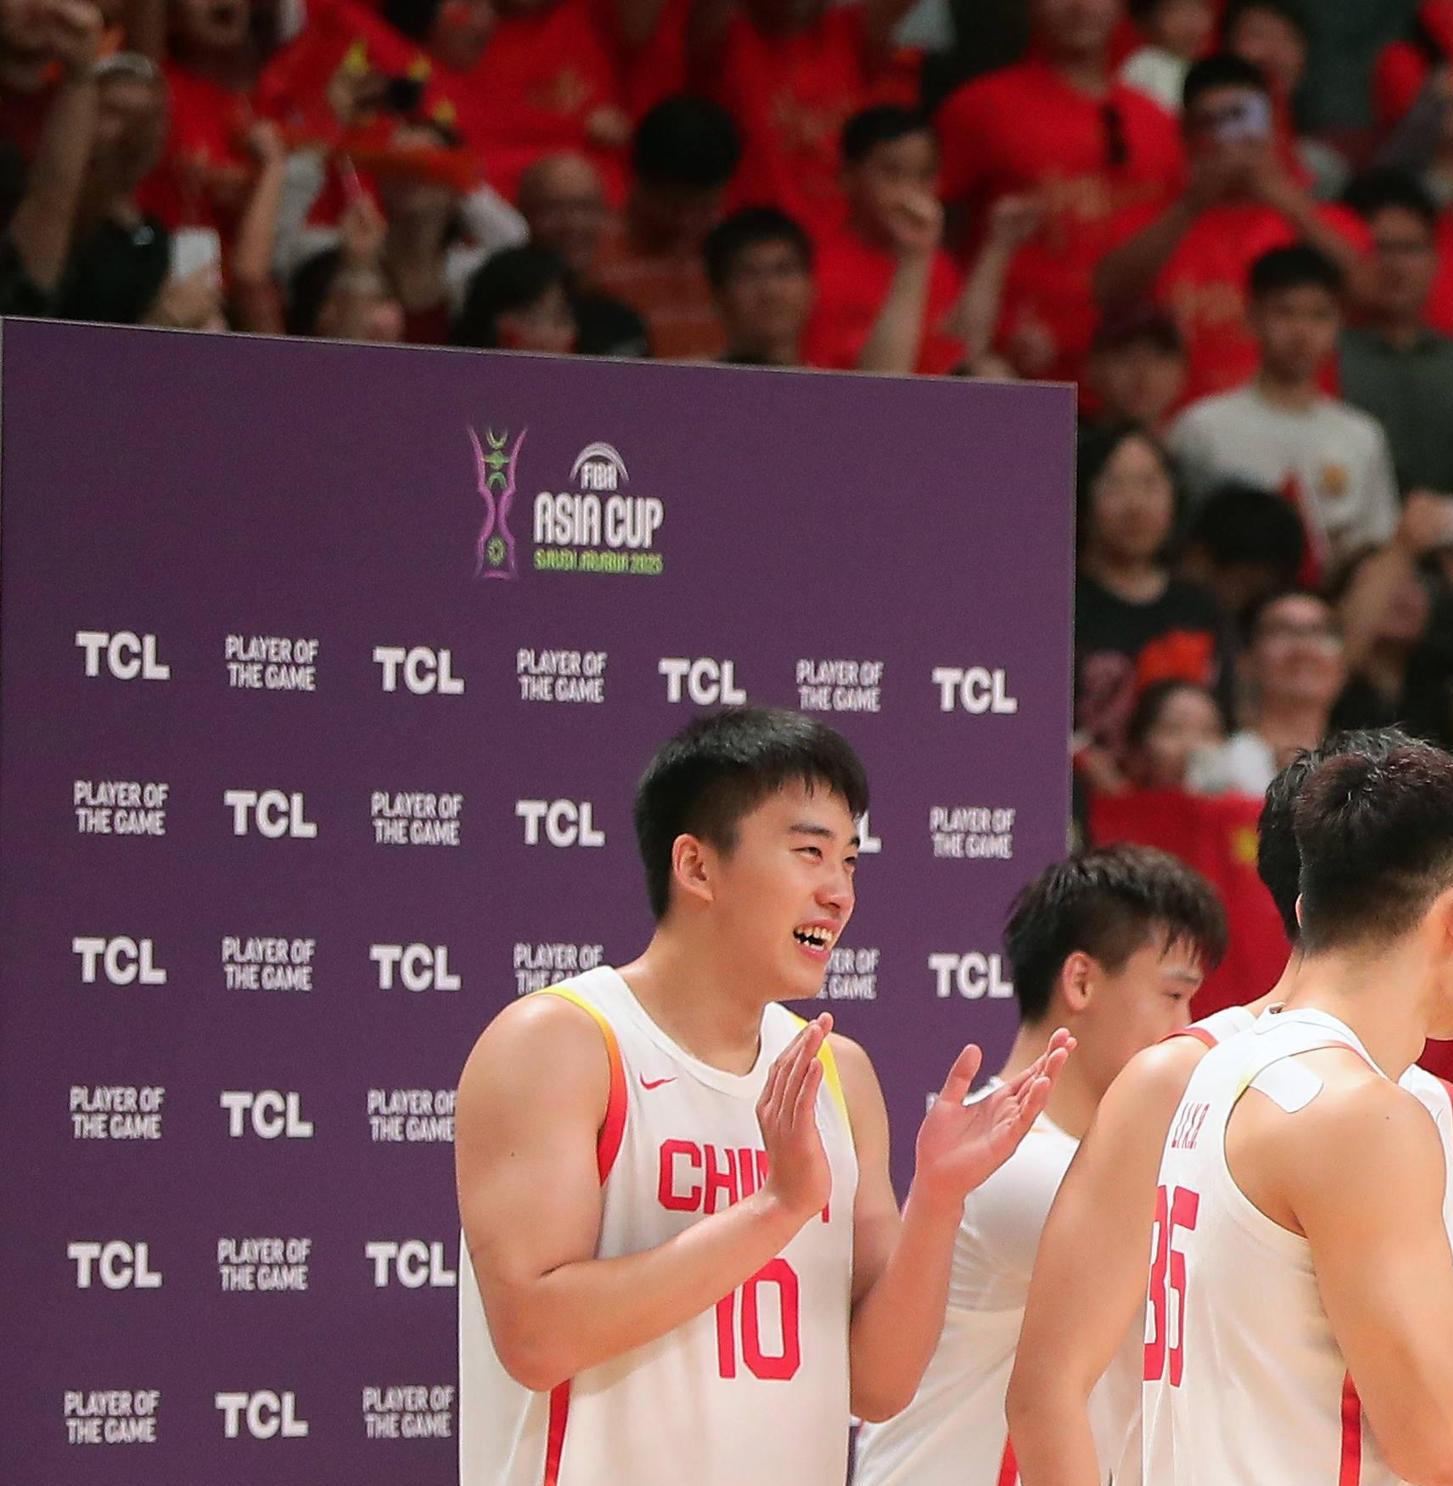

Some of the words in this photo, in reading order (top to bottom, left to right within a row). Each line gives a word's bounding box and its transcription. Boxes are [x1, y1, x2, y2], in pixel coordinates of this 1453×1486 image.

[580, 459, 619, 491] FIBA
[533, 491, 603, 546] ASIA
[604, 495, 665, 549] CUP
[75, 630, 170, 680] TCL
[225, 635, 292, 662] PLAYER
[293, 638, 319, 665] OF
[516, 648, 581, 674] PLAYER
[582, 651, 608, 677] OF
[227, 662, 263, 689] THE
[264, 664, 316, 691] GAME
[372, 646, 465, 695] TCL
[658, 657, 747, 706] TCL
[796, 659, 859, 685] PLAYER
[860, 662, 884, 688] OF
[518, 674, 554, 702] THE
[555, 676, 605, 704] GAME
[798, 684, 832, 711] THE
[833, 686, 882, 713] GAME
[931, 666, 1018, 715] TCL
[73, 780, 142, 806] PLAYER
[143, 783, 169, 809] OF
[371, 791, 437, 816] PLAYER
[438, 794, 463, 819] OF
[75, 807, 112, 834] THE
[113, 809, 166, 836] GAME
[223, 789, 318, 838] TCL
[515, 798, 605, 847] TCL
[929, 806, 991, 832] PLAYER
[992, 809, 1016, 835] OF
[372, 818, 408, 844] THE
[409, 820, 460, 846] GAME
[931, 831, 964, 857] THE
[965, 833, 1013, 859] GAME
[72, 936, 167, 985] TCL
[222, 936, 289, 962] PLAYER
[290, 939, 315, 965] OF
[513, 943, 577, 970] PLAYER
[579, 944, 604, 968] OF
[856, 948, 881, 974] OF
[223, 963, 260, 989] THE
[261, 965, 313, 991] GAME
[369, 942, 461, 992] TCL
[927, 951, 1014, 1000] TCL
[829, 974, 877, 1000] GAME
[69, 1086, 138, 1110] PLAYER
[139, 1089, 166, 1113] OF
[367, 1089, 432, 1115] PLAYER
[71, 1113, 108, 1138] THE
[109, 1115, 162, 1140] GAME
[220, 1090, 314, 1139] TCL
[369, 1116, 404, 1141] THE
[405, 1116, 455, 1142] GAME
[658, 1138, 830, 1223] CHI
[67, 1240, 162, 1290] TCL
[217, 1238, 285, 1261] PLAYER
[286, 1241, 312, 1264] OF
[364, 1239, 458, 1289] TCL
[219, 1264, 255, 1289] THE
[256, 1266, 309, 1291] GAME
[715, 1257, 801, 1381] 10
[63, 1389, 133, 1414] PLAYER
[134, 1392, 161, 1417] OF
[362, 1385, 428, 1409] PLAYER
[429, 1388, 456, 1412] OF
[214, 1390, 309, 1439] TCL
[365, 1412, 400, 1437] THE
[401, 1414, 453, 1439] GAME
[65, 1417, 103, 1442] THE
[104, 1419, 157, 1444] GAME
